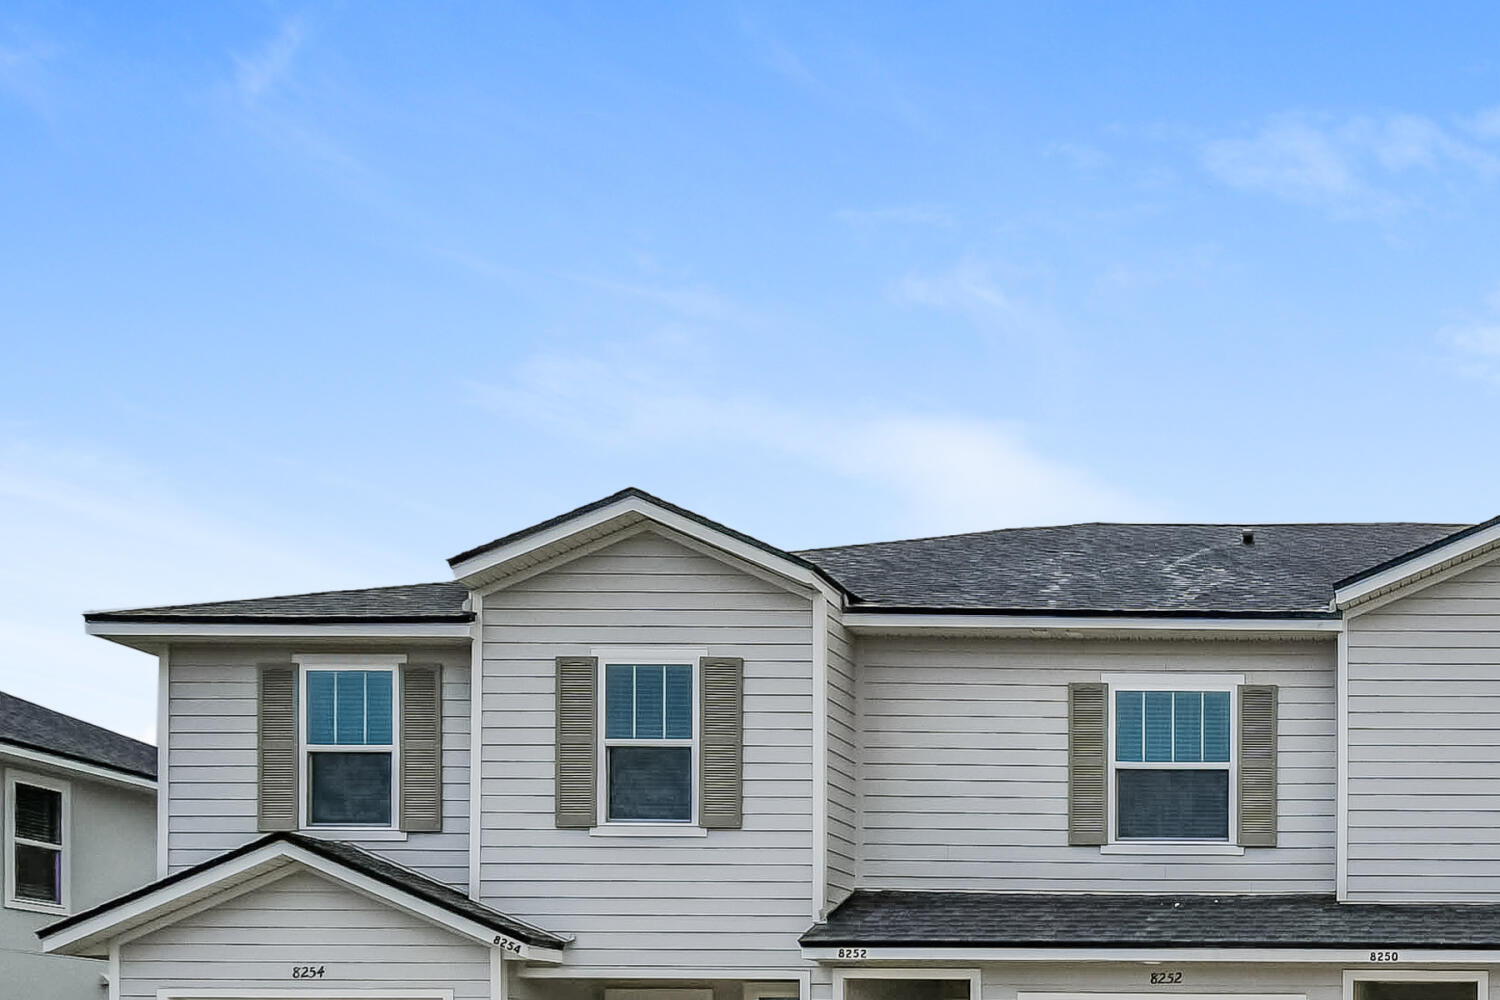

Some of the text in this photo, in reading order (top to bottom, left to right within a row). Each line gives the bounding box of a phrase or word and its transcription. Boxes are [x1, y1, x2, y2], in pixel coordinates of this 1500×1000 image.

[493, 935, 522, 954] 8254
[838, 949, 867, 959] 8252
[1370, 952, 1398, 962] 8250
[292, 966, 325, 978] 8254
[1150, 972, 1182, 984] 8252
